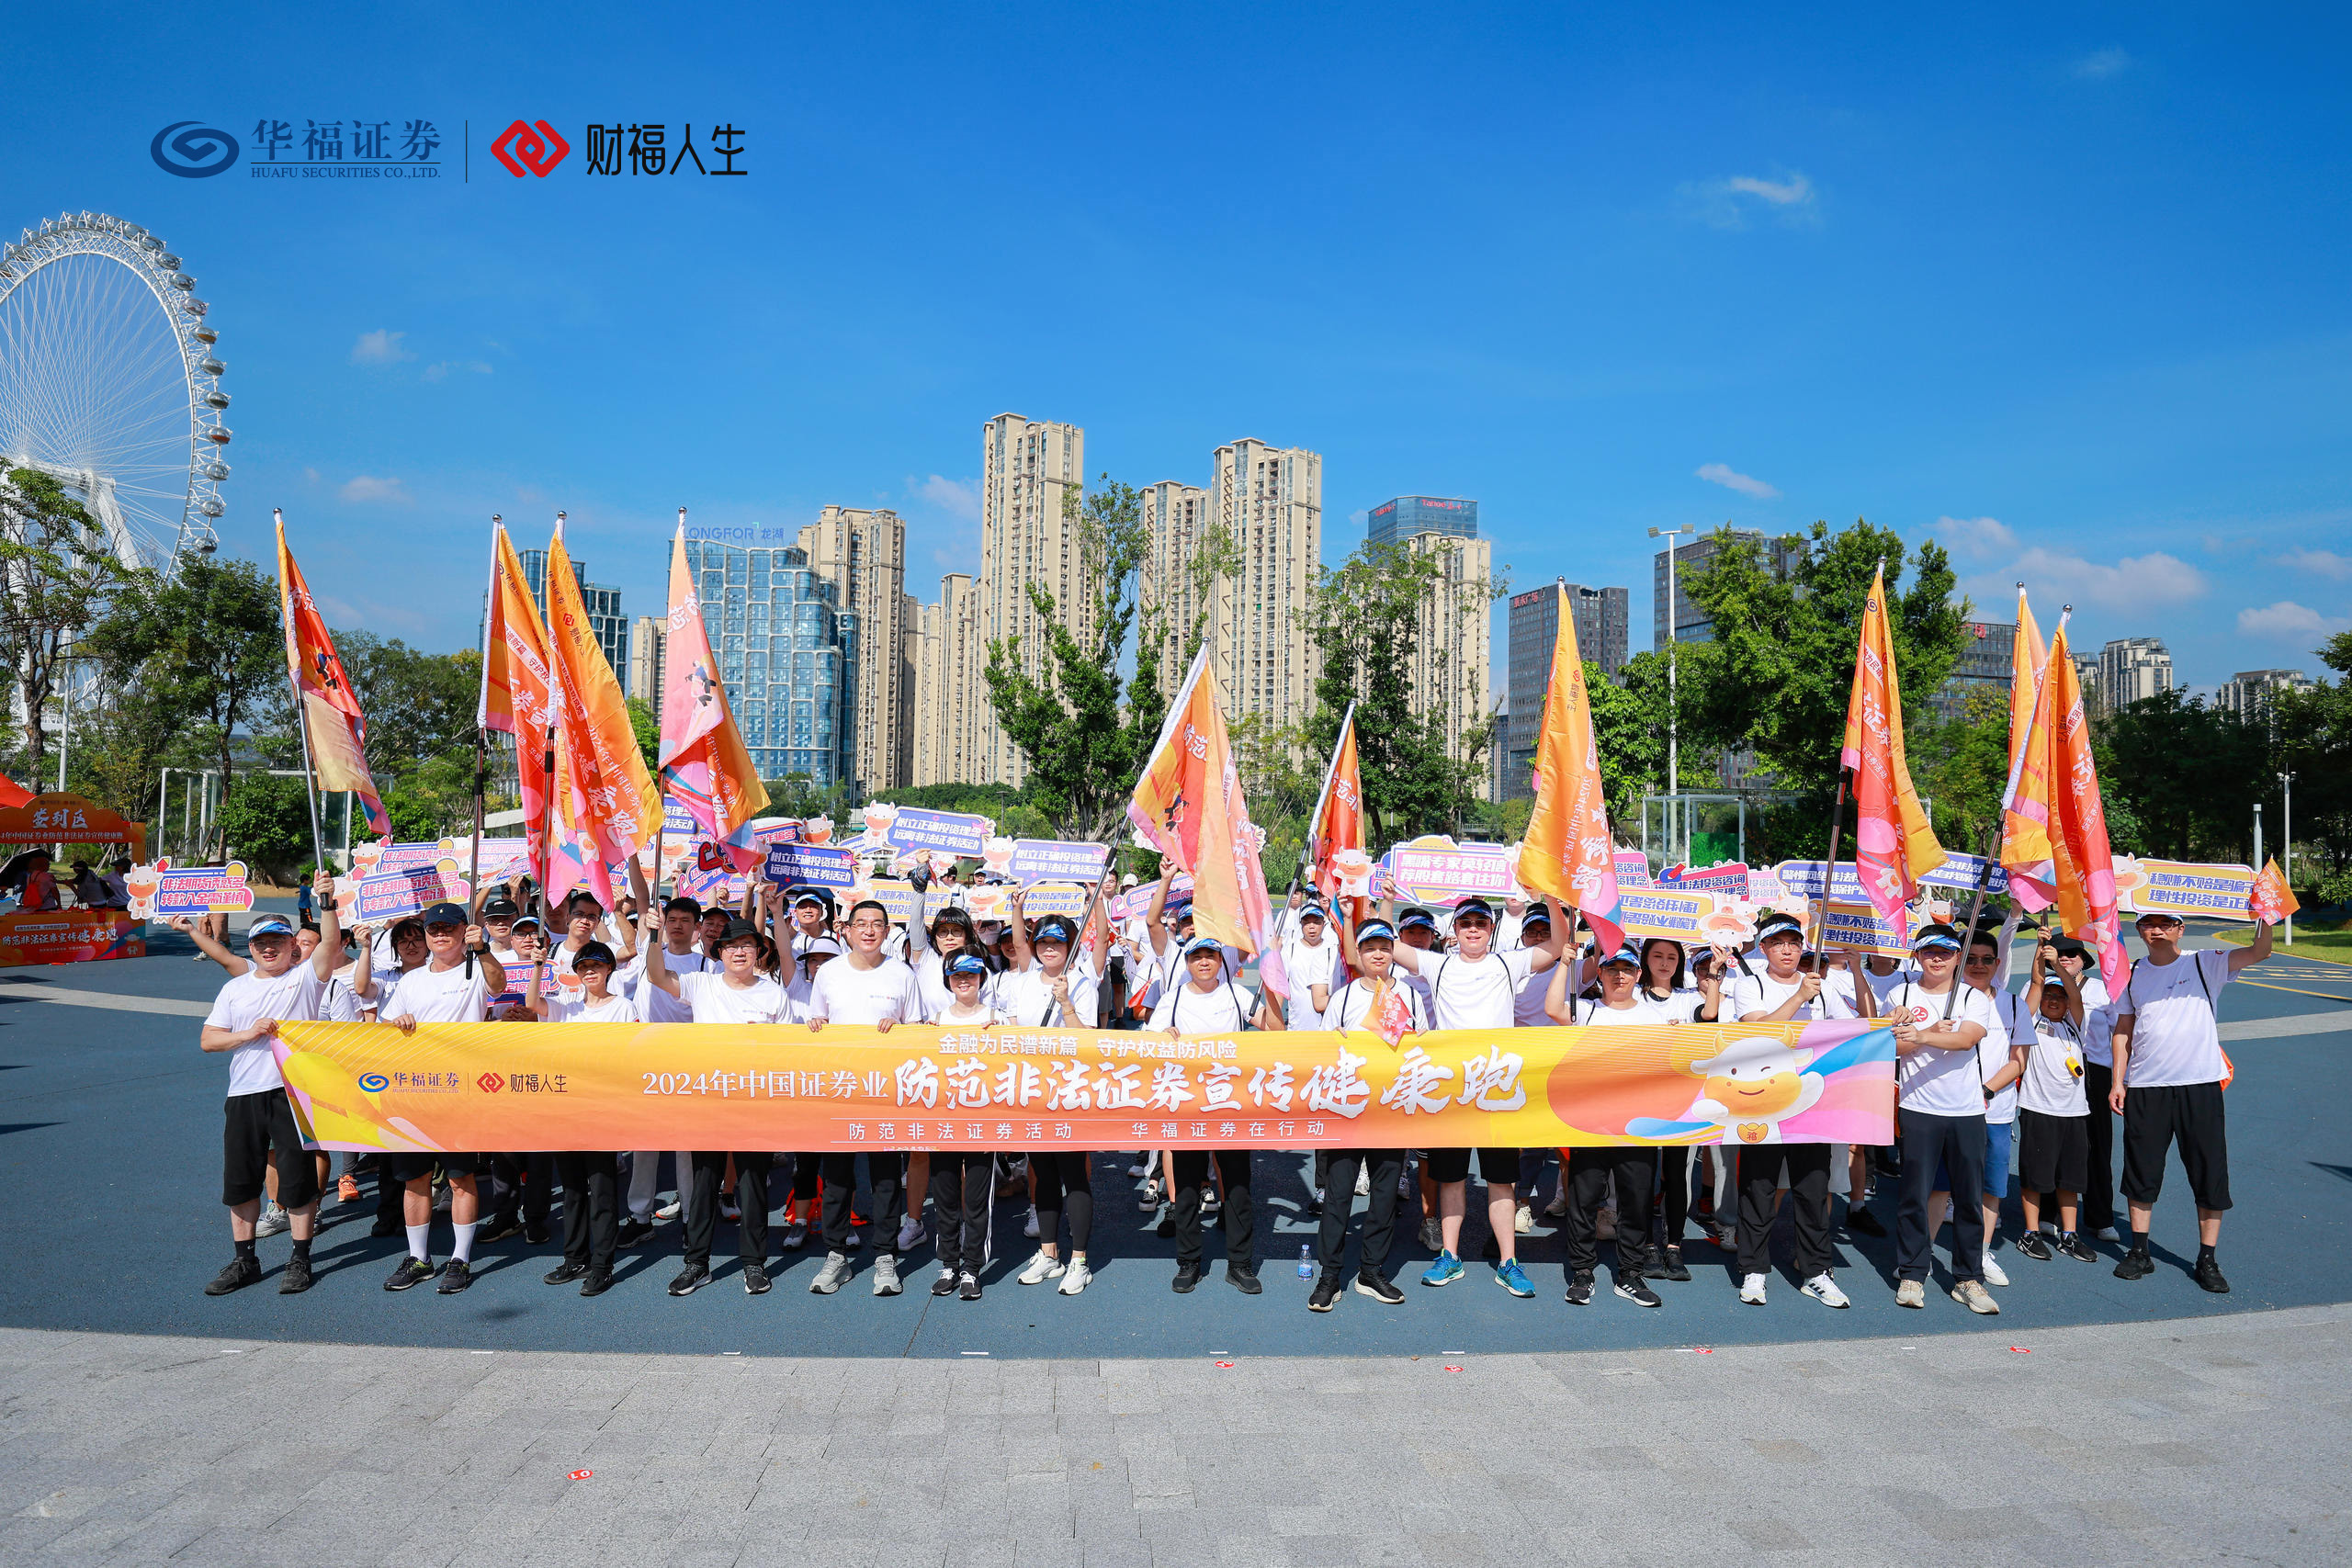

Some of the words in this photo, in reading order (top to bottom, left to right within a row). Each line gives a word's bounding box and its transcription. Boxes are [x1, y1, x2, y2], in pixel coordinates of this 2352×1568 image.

[684, 527, 754, 539] ONGFOR
[896, 816, 982, 838] 树立正确投资理念
[893, 829, 980, 851] 远离非法证券活动
[771, 851, 852, 870] 树立正确投资理念
[1015, 848, 1104, 865] 树立正确投资理念
[770, 863, 852, 883] 远离非法证券活动
[1014, 860, 1104, 876] 远离非法证券活动
[1400, 868, 1507, 887] 荐股套路套住你
[160, 889, 245, 907] 转款入金需谨慎
[362, 885, 460, 913] 转款入金需谨慎
[1912, 1008, 1928, 1021] 02
[938, 1034, 1079, 1056] 金融为民谱新篇
[1098, 1038, 1238, 1059] 守护权益防风险
[392, 1072, 459, 1087] 华福证券
[510, 1073, 568, 1093] 财福人生
[642, 1067, 890, 1100] 2024年中国证券业
[895, 1044, 1528, 1119] 防范非法证券宣传健康跑
[848, 1122, 1072, 1140] 防范非法证券活动
[1131, 1120, 1325, 1139] 华福证券在行动
